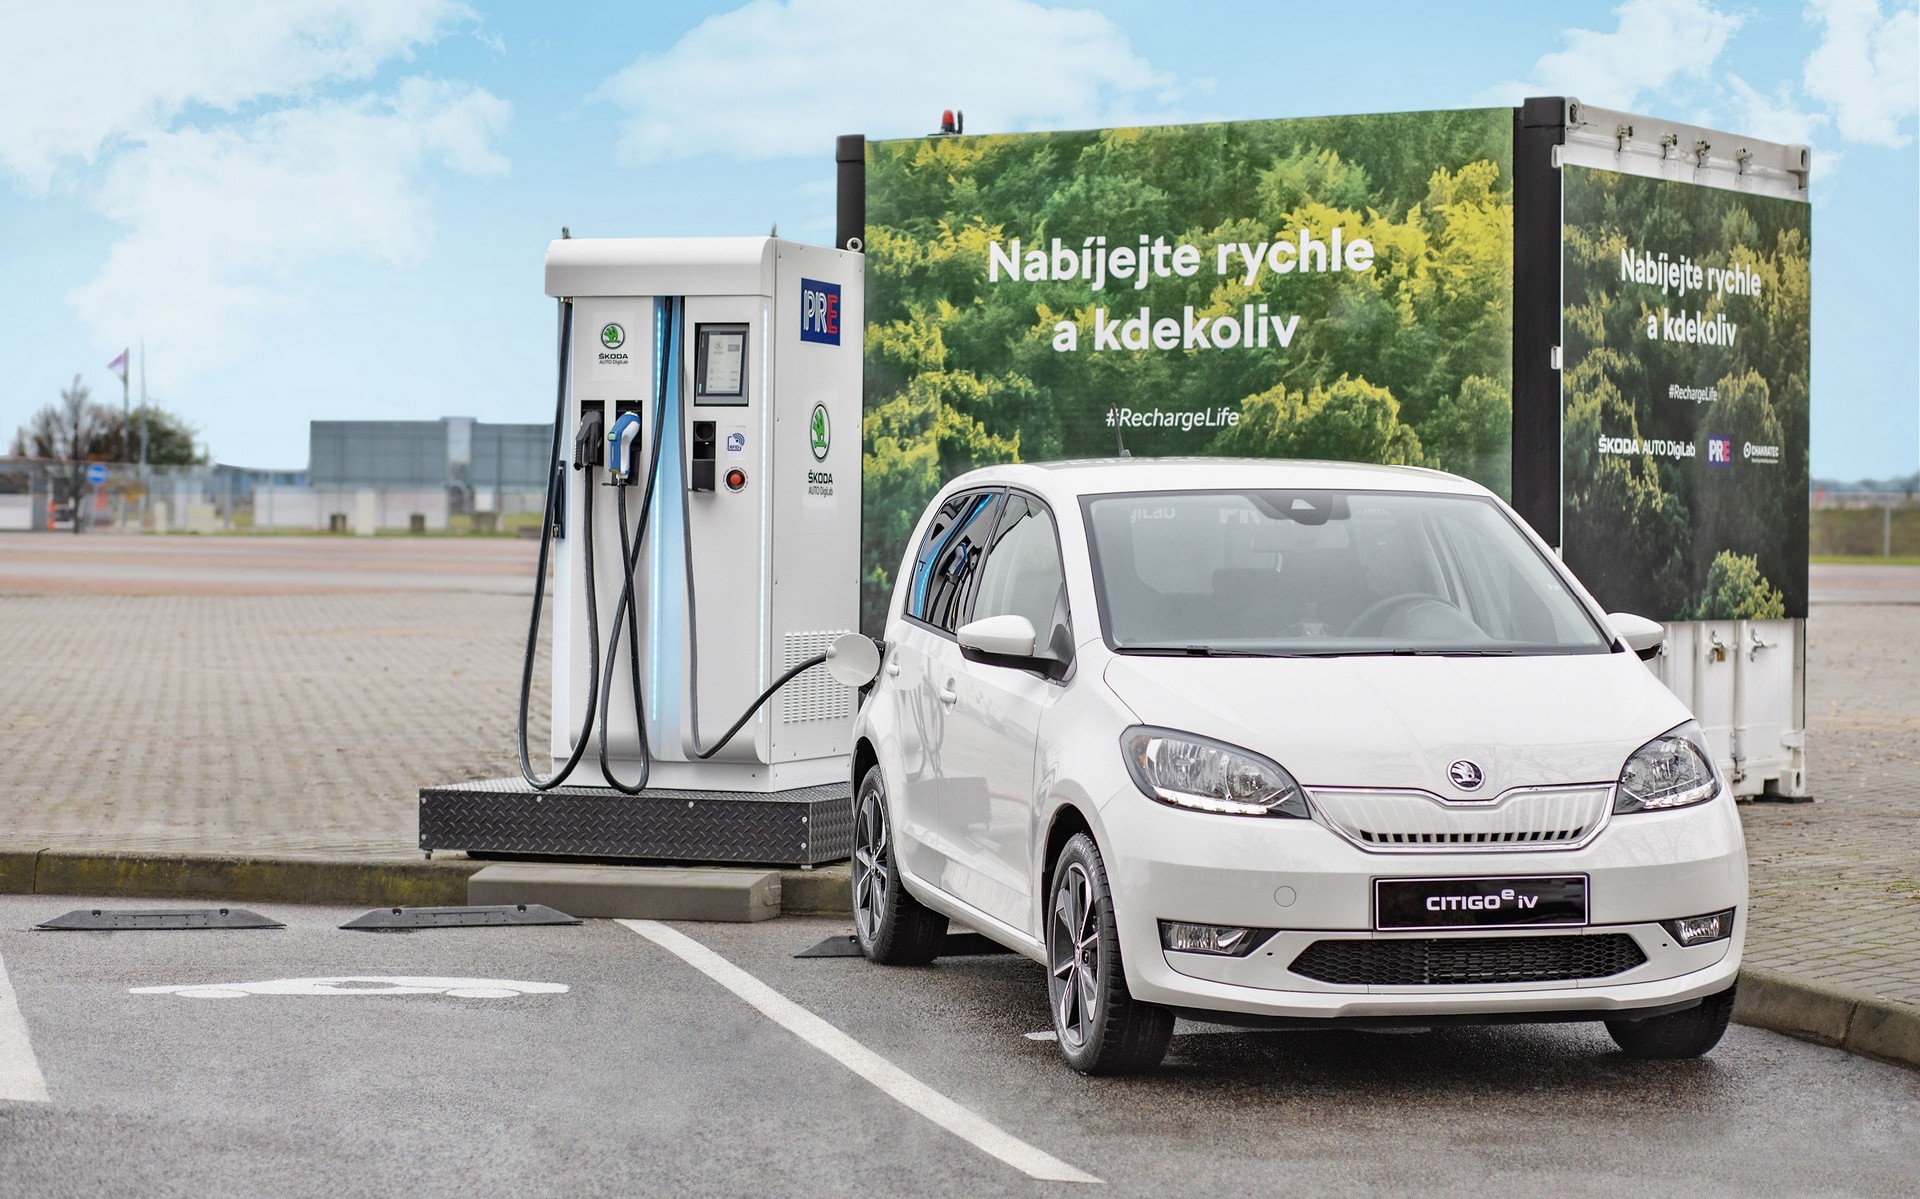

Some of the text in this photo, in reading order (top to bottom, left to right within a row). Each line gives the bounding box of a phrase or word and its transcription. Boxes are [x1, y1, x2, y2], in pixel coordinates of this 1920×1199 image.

[988, 227, 1375, 291] Nabíjejte rychle
[1620, 247, 1762, 301] Nabíjejte rychle
[803, 289, 838, 335] PRE
[1052, 304, 1301, 352] a kdekoliv
[1647, 308, 1738, 347] a kdekoliv
[598, 352, 629, 360] ŠKODA
[1668, 384, 1718, 404] #RechargeLife
[1105, 406, 1240, 431] #RechargeLife
[1598, 434, 1696, 460] ŠKODA AUTO DigiLab
[1708, 439, 1731, 462] PRE
[808, 469, 834, 485] ŠKODA
